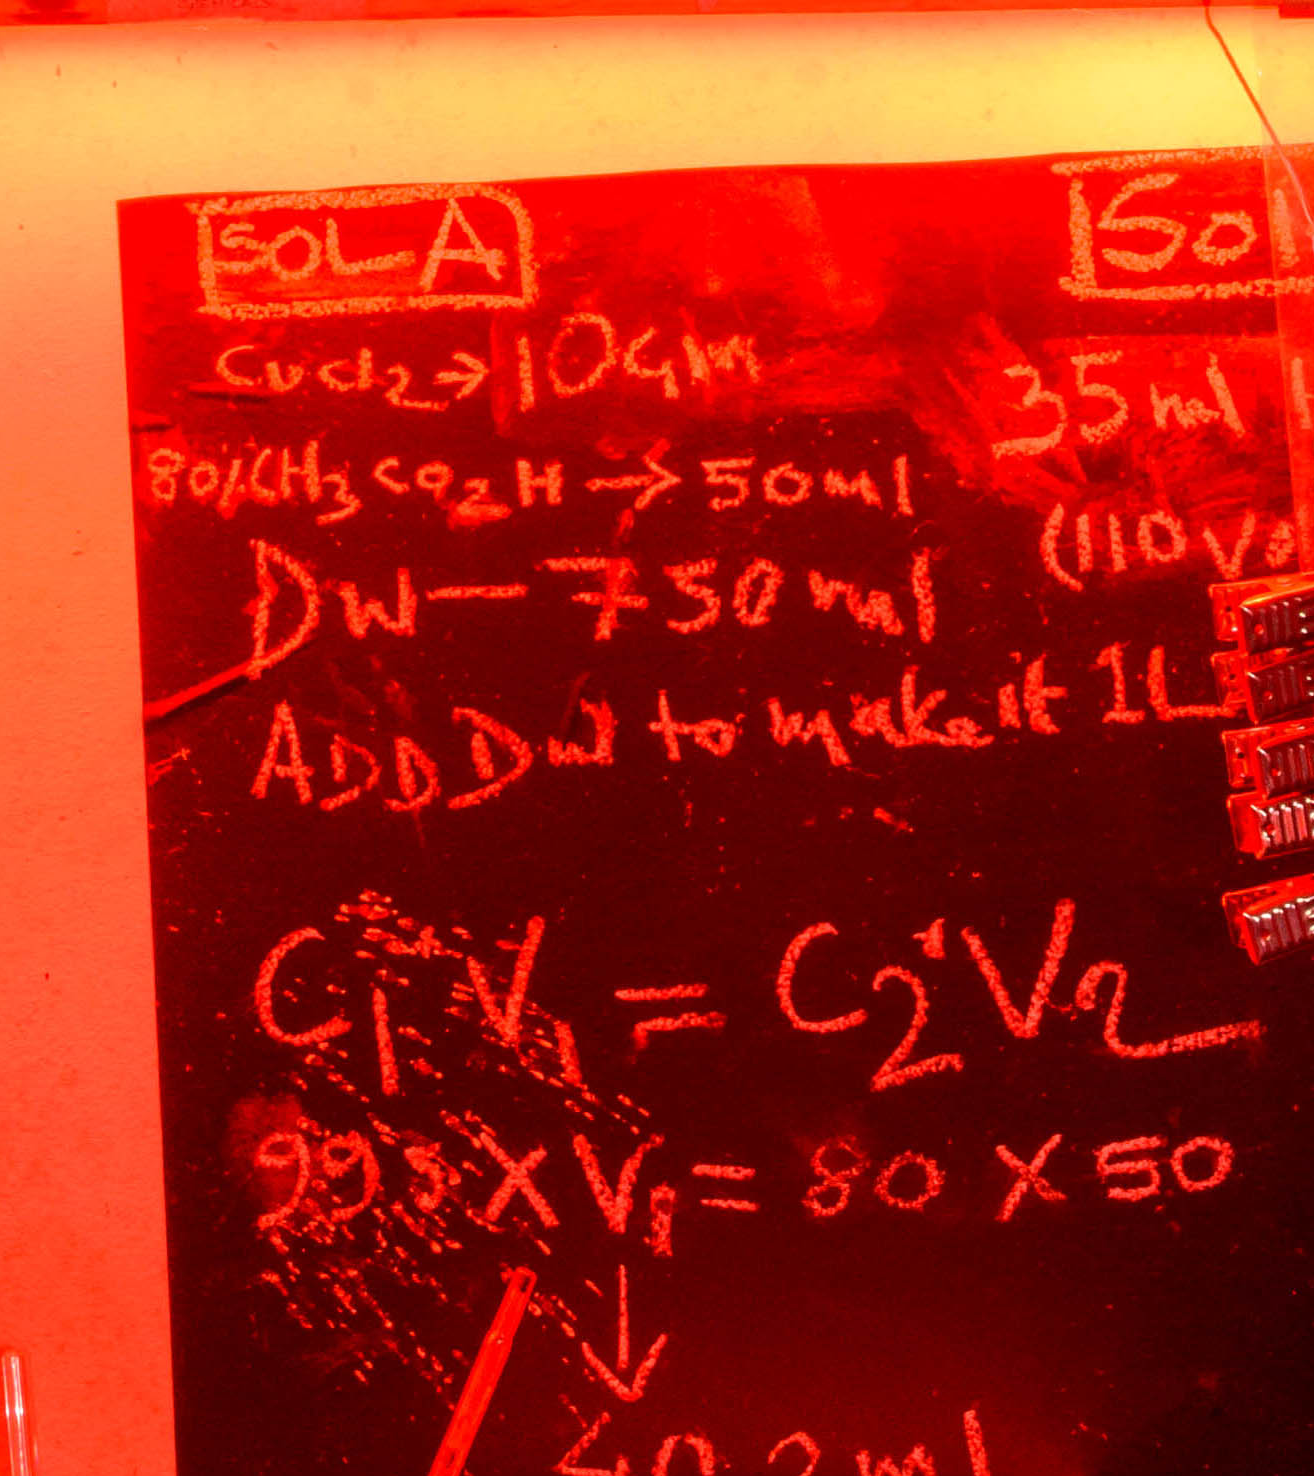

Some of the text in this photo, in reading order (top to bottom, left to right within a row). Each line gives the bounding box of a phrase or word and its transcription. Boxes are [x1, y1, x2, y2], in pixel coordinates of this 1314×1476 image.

[646, 687, 745, 765] to
[762, 662, 998, 770] make
[802, 1140, 947, 1222] 80
[1092, 1133, 1237, 1204] 50
